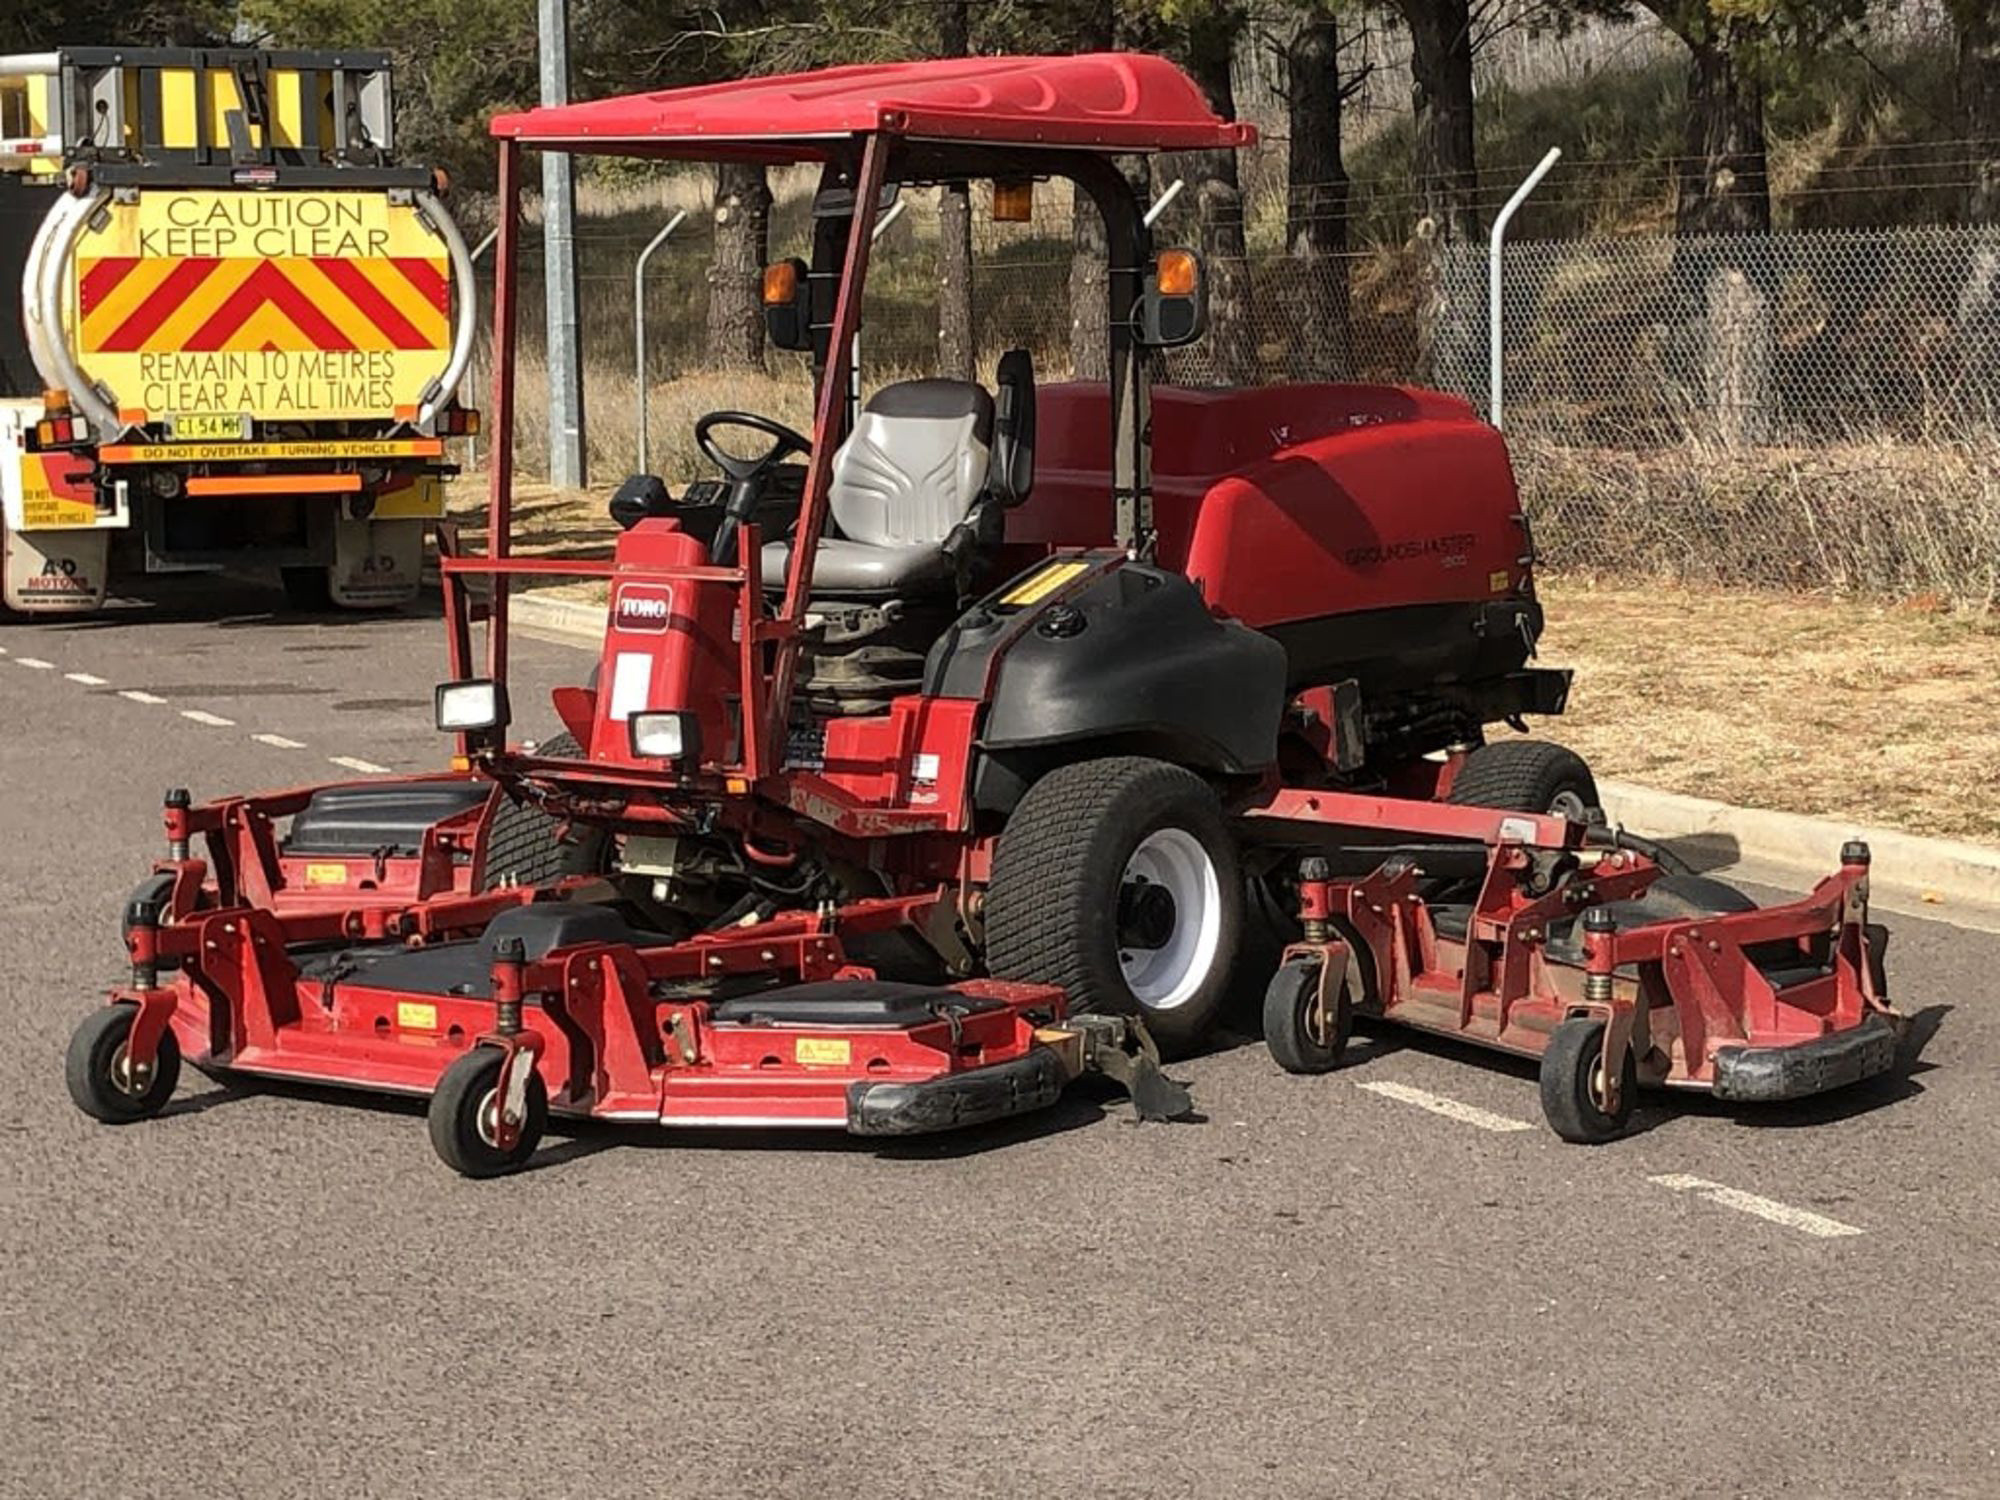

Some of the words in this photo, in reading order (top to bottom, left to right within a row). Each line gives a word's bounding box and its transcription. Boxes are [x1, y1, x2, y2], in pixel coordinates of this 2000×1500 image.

[167, 197, 362, 227] CAUTION
[140, 228, 237, 258] KEEP
[253, 228, 390, 258] CLEAR
[140, 351, 247, 381] REMAIN
[298, 350, 395, 379] METRES
[144, 382, 227, 412] CLEAR
[238, 382, 267, 411] AT
[275, 381, 319, 410] ALL
[326, 380, 393, 409] TIMES
[143, 447, 163, 459] DO
[167, 447, 194, 459] NOT
[200, 446, 269, 458] OVERTAKE
[280, 444, 337, 456] TURNING
[342, 443, 396, 455] VEHICLE
[621, 597, 667, 618] TORO
